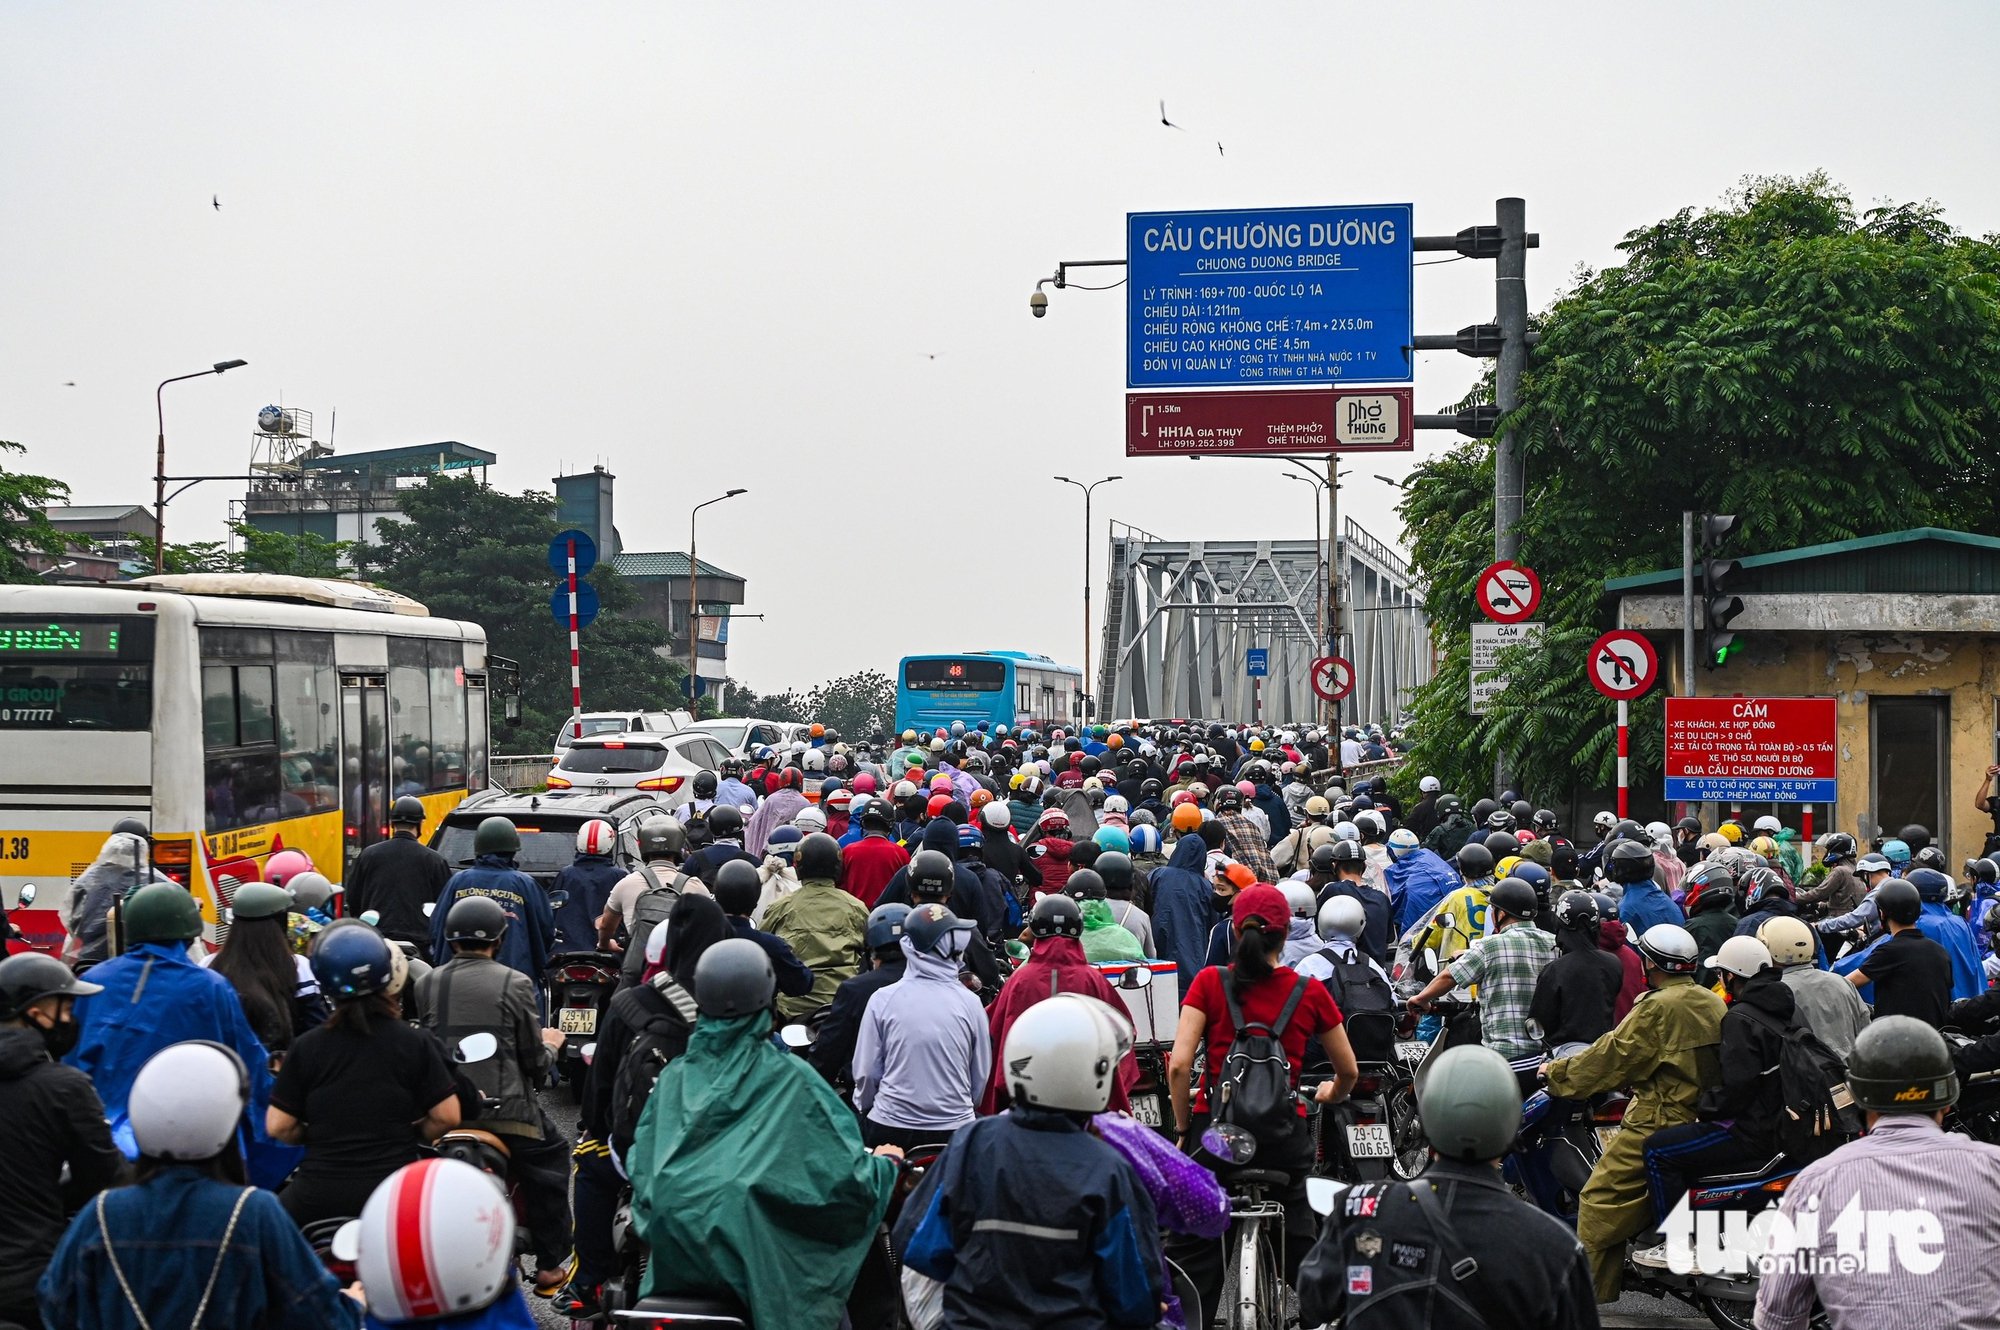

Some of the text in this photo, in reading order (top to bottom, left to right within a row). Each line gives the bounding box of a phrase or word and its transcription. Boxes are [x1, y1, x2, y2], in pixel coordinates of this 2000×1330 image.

[1144, 218, 1395, 252] CẦU CHƯƠNG DƯƠNG
[1196, 253, 1341, 271] CHUONG DUONG BRIDGE
[1143, 285, 1156, 300] LÝ
[1253, 280, 1286, 298] QUỐC
[1290, 281, 1305, 299] LỘ
[1310, 284, 1323, 296] 1A
[1182, 318, 1216, 337] RỘNG
[1220, 316, 1262, 334] KHỐNG
[1182, 340, 1205, 352] CAO
[1209, 335, 1250, 352] KHỐNG
[1143, 356, 1168, 371] ĐƠN
[1171, 358, 1182, 373] VỊ
[1185, 354, 1217, 371] QUẢN
[1240, 352, 1264, 364] CÔNG
[1267, 353, 1279, 363] TY
[1282, 353, 1305, 363] TNHH
[1365, 351, 1377, 361] TV
[1240, 365, 1264, 378] CÔNG
[1296, 366, 1308, 377] GT
[1327, 363, 1342, 378] NỘI
[1157, 404, 1181, 413] 1.5Km
[1158, 426, 1243, 438] HH1A GIA THỤY
[1267, 422, 1295, 434] THÈM
[1174, 439, 1235, 448] 0919.252.398
[1267, 433, 1327, 445] GHÉ THÚNG!
[1497, 624, 1518, 636] CẤM
[949, 665, 962, 677] 48
[7, 688, 66, 703] GROUP
[1732, 698, 1768, 718] CẤM
[1719, 721, 1731, 729] XE
[1733, 721, 1750, 730] HỢP
[1687, 732, 1699, 740] DU
[1700, 732, 1719, 741] LỊCH
[1728, 732, 1733, 740] 9
[1715, 743, 1742, 752] TRỌNG
[1744, 740, 1757, 751] TẢI
[1759, 741, 1781, 751] TOÀN
[1783, 741, 1795, 753] BỘ
[1816, 740, 1833, 752] TẤN
[1709, 754, 1719, 762] XE
[1792, 753, 1804, 764] BỘ
[1683, 762, 1814, 775] QUA CẦU CHƯƠNG DƯƠNG
[1739, 781, 1755, 790] HỌC
[1781, 782, 1792, 790] XE
[1702, 789, 1797, 801] ĐƯỢC PHÉP HOẠT ĐỘNG
[561, 1022, 593, 1033] 667.12
[1353, 1127, 1384, 1141] 29-C2
[1352, 1141, 1390, 1156] 006.65
